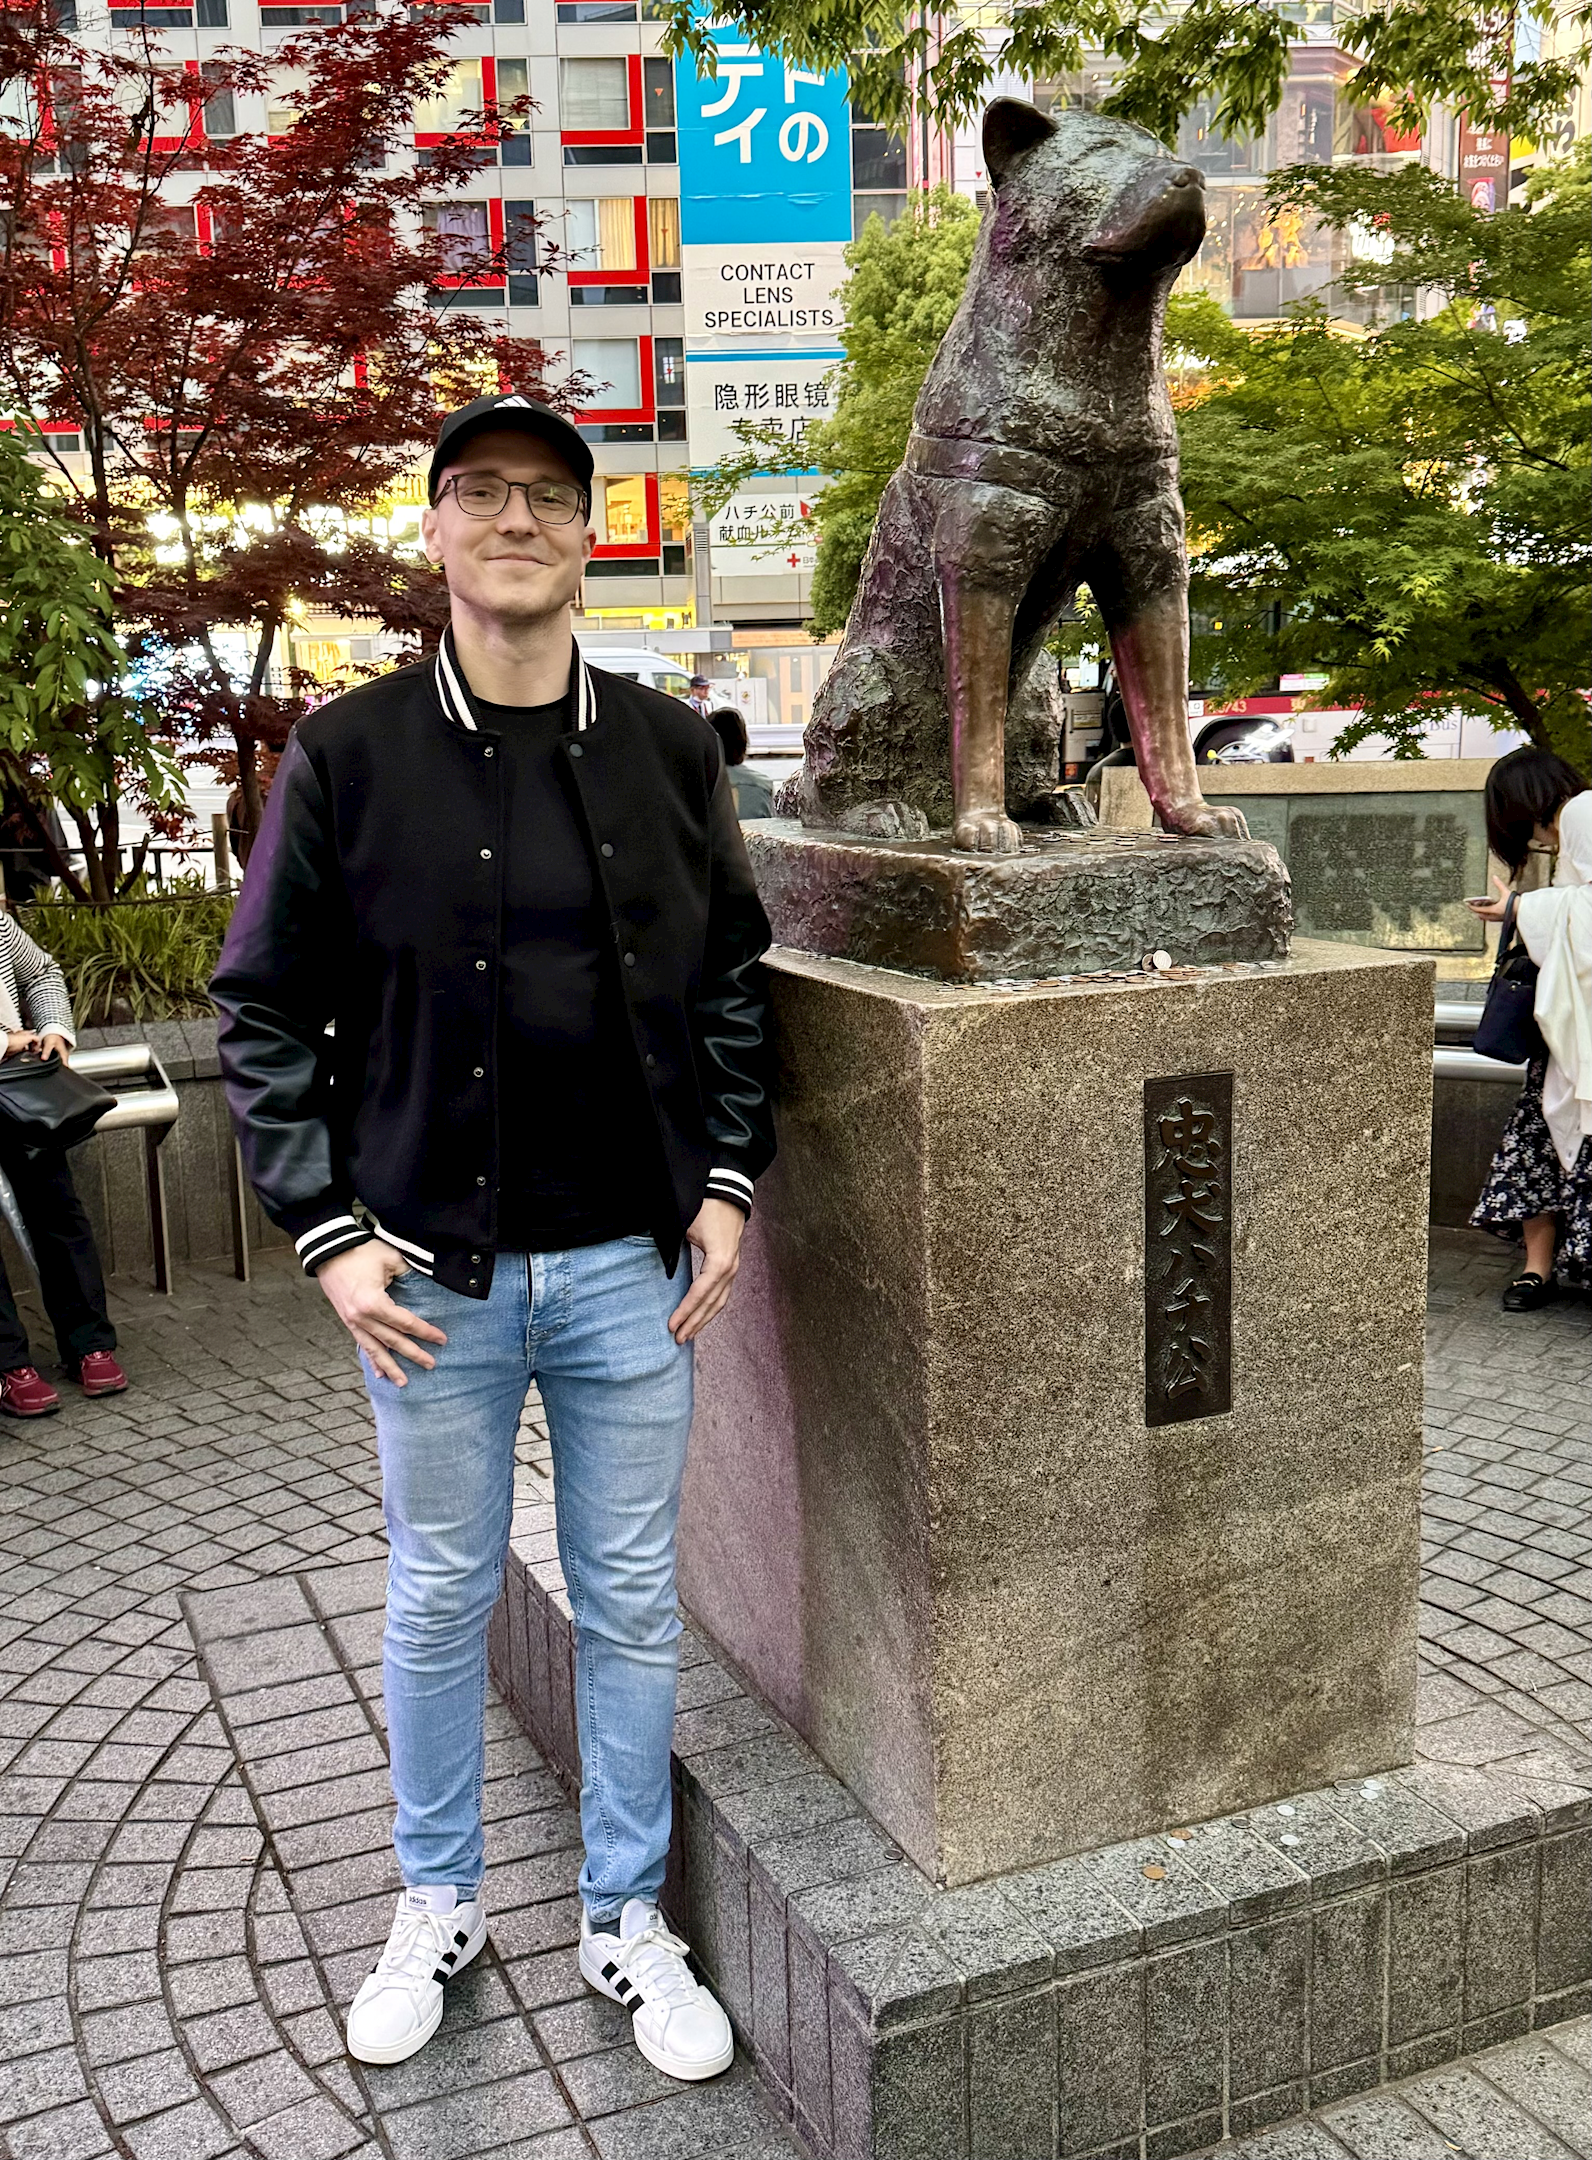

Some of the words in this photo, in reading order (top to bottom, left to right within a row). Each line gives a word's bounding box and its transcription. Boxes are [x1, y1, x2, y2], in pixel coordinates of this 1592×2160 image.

[695, 17, 768, 163] ティ
[720, 263, 816, 282] CONTACT
[743, 287, 794, 304] LENS
[704, 309, 834, 328] SPECIALISTS
[714, 382, 830, 411] 隐形眼镜
[725, 503, 795, 520] ハチ公前
[719, 525, 799, 542] 献血ル
[1151, 1096, 1224, 1400] 忠犬ハチ公
